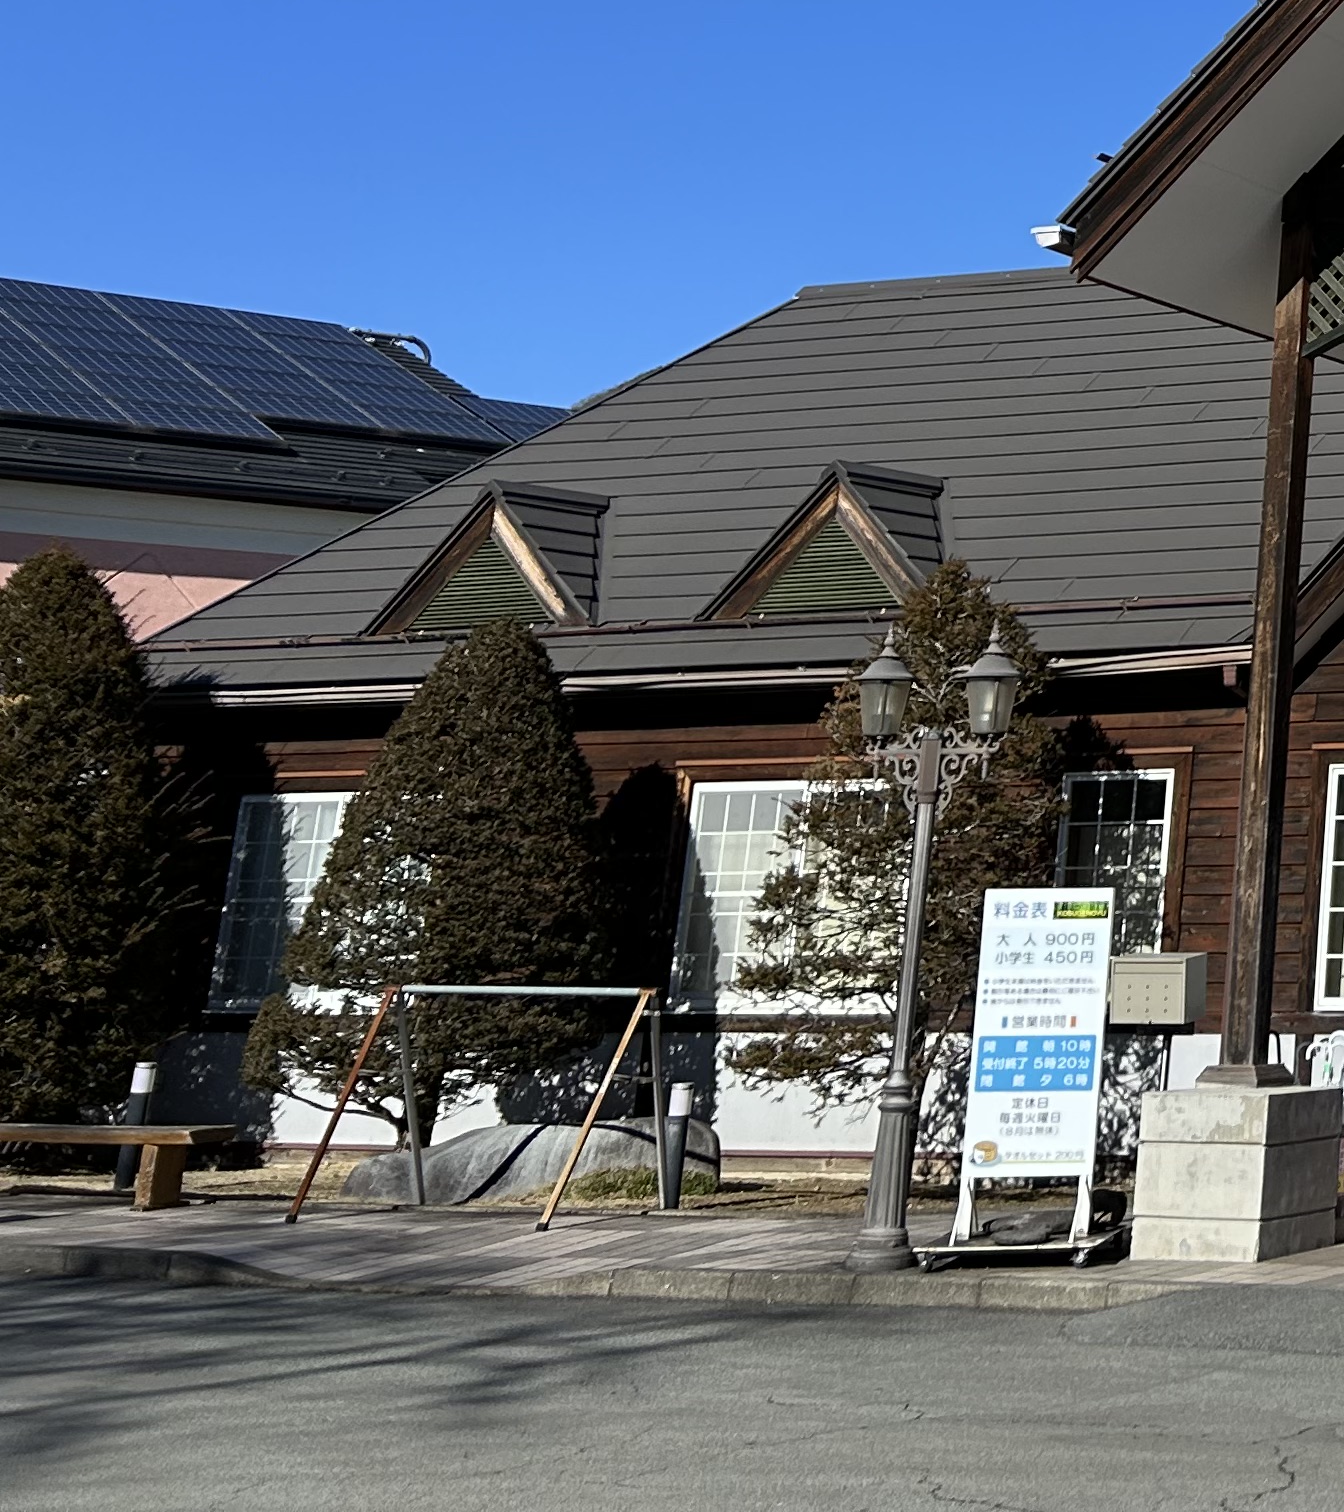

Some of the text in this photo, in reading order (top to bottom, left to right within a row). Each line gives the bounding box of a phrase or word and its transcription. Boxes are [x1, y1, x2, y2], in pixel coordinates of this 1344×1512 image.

[994, 901, 1047, 919] 料金表
[1045, 932, 1095, 946] 900円
[995, 950, 1094, 964] 小学生 450円
[1012, 1015, 1067, 1028] 営業時間
[982, 1056, 1090, 1070] 受付終了 5時20分
[1012, 1097, 1049, 1109] 定休日
[999, 1112, 1061, 1124] 毎週火曜日
